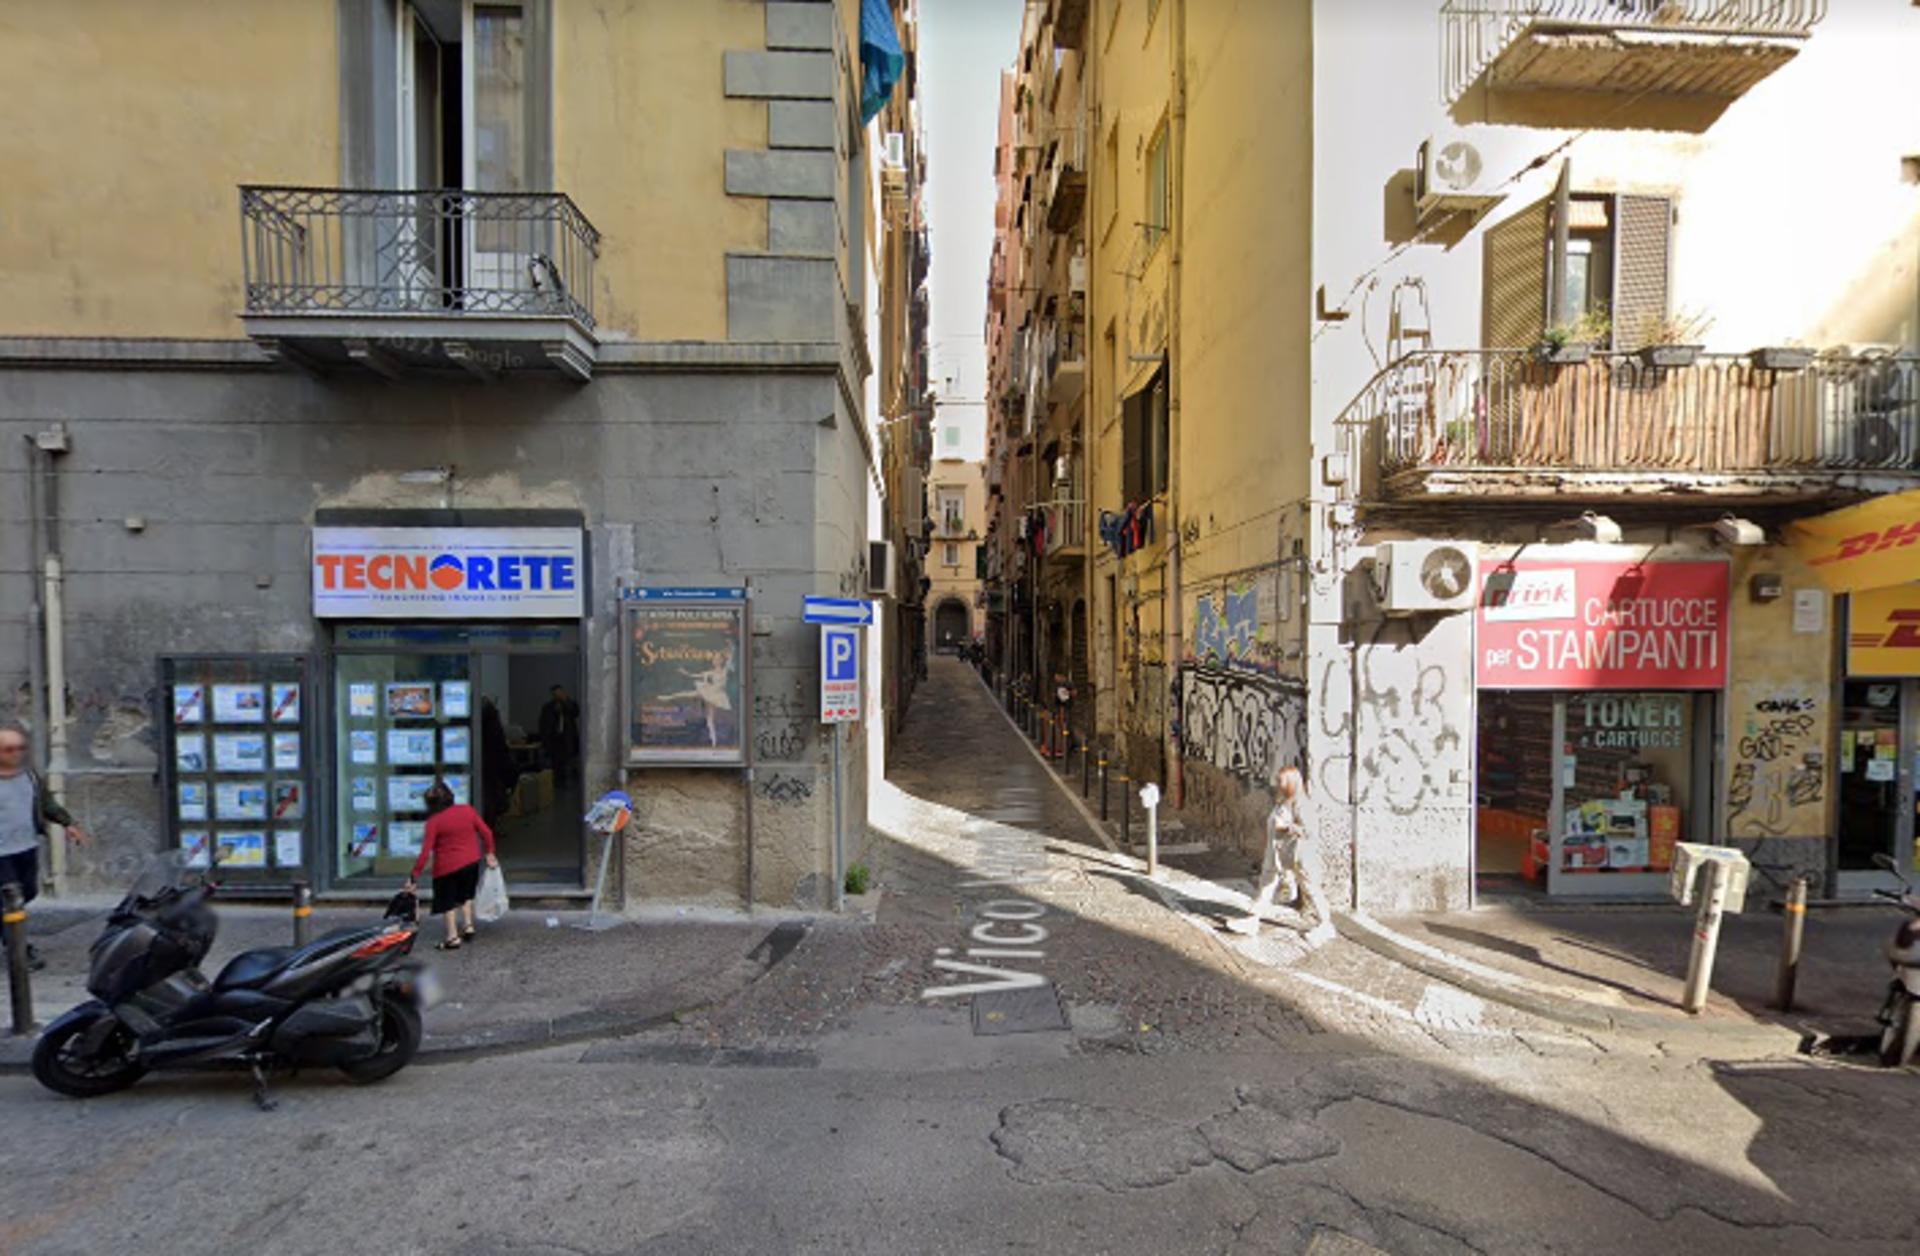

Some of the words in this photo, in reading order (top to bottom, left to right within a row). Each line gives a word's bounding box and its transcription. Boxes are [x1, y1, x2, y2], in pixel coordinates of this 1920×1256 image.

[316, 553, 575, 590] TECNORETE
[1584, 597, 1718, 627] CARTUCCE
[831, 636, 852, 678] P
[1485, 649, 1512, 669] per
[1516, 629, 1718, 671] STAMPANTI
[1584, 697, 1682, 727] TONER
[1595, 730, 1681, 748] CARTUCCE
